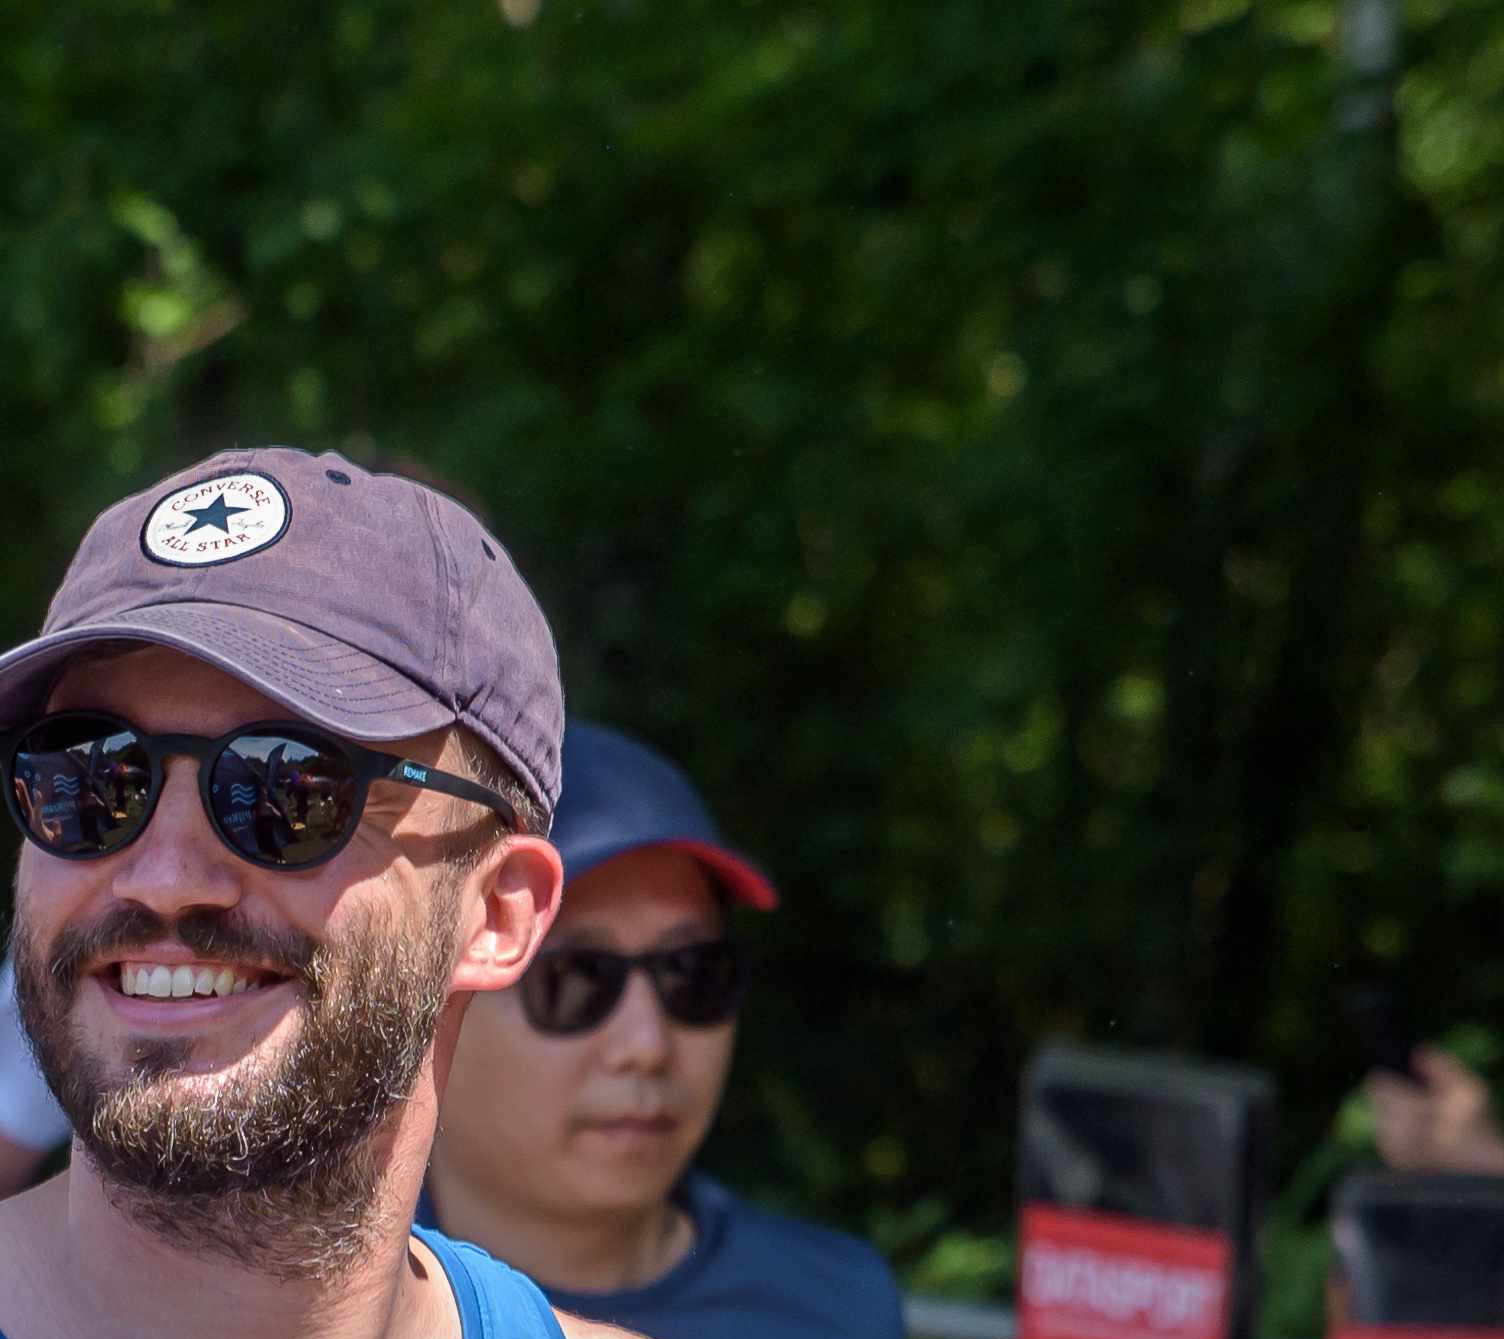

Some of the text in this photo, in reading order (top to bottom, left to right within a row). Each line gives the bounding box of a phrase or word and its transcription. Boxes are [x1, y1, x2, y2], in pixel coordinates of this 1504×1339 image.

[171, 480, 271, 512] CONVERSE
[161, 532, 251, 552] ALL STAR
